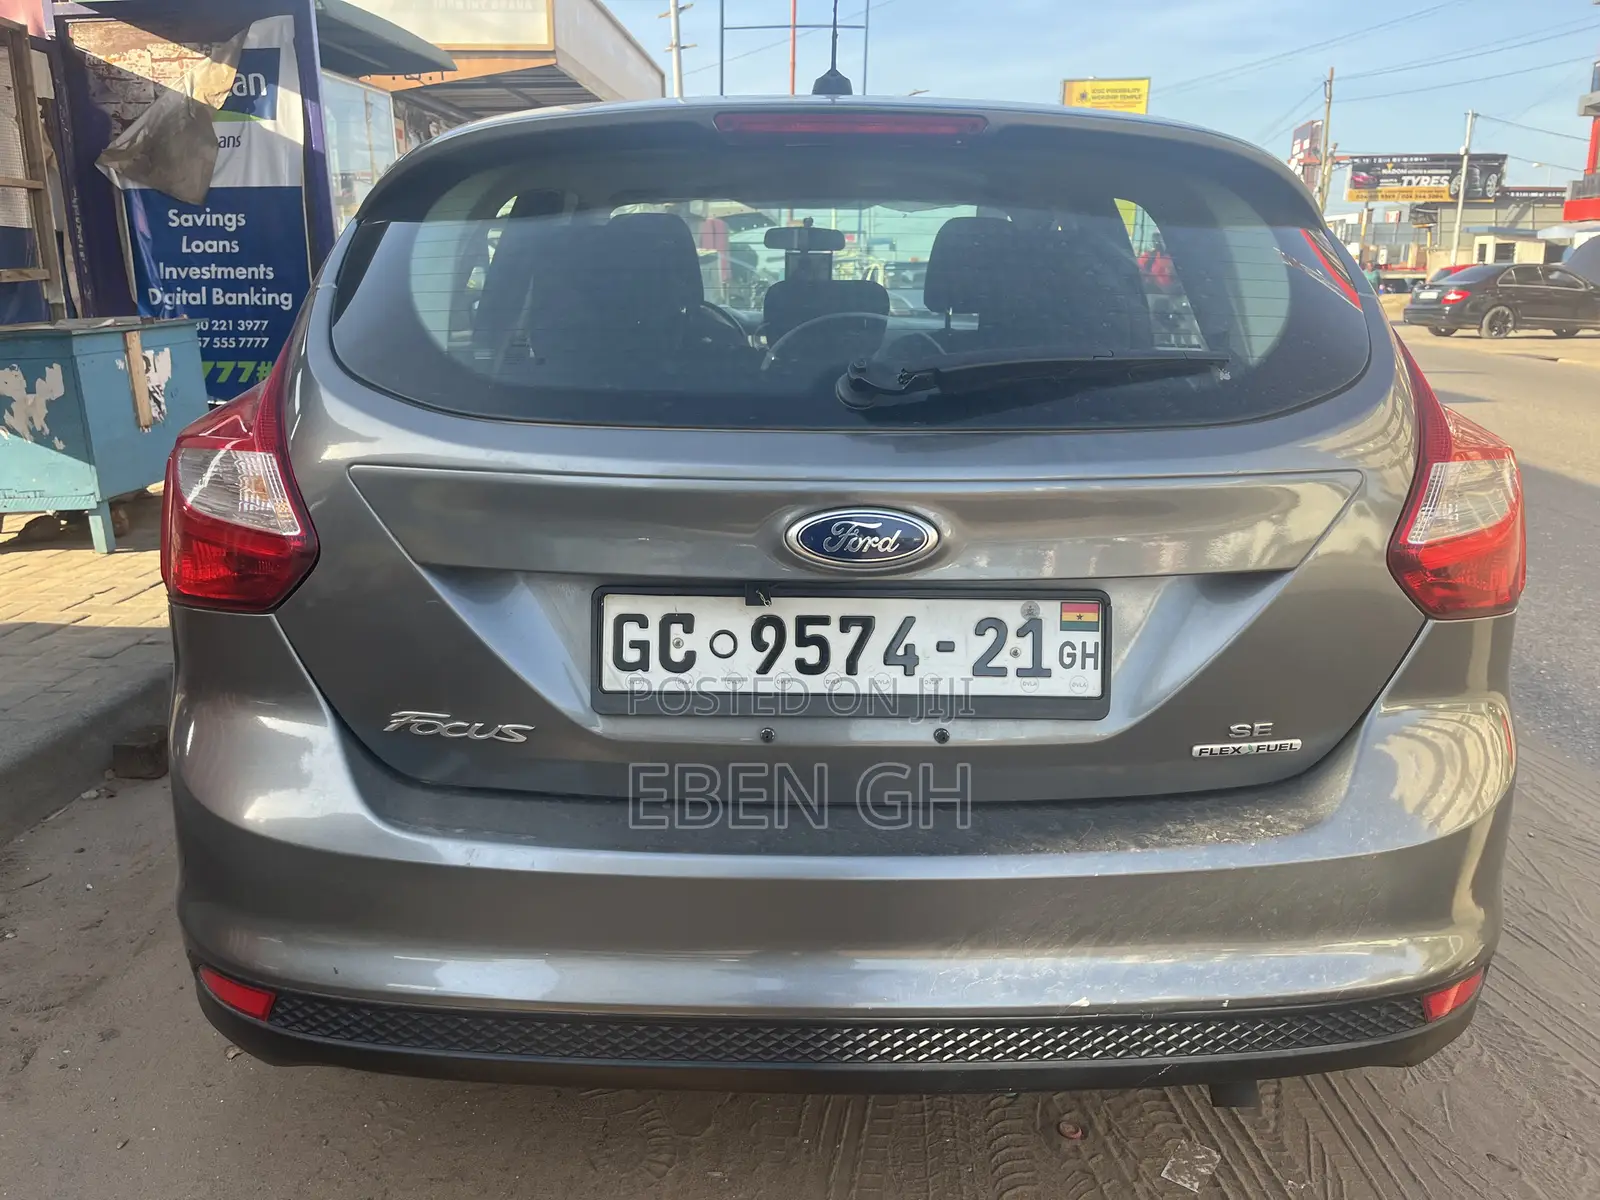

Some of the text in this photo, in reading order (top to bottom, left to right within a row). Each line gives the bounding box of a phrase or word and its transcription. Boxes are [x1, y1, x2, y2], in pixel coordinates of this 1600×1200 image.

[229, 73, 267, 97] an
[1401, 175, 1450, 187] TYRES
[168, 207, 246, 232] Savings
[181, 236, 240, 254] Loans
[159, 262, 275, 280] Investments
[212, 286, 293, 310] Banking
[211, 320, 233, 331] 221
[237, 320, 269, 331] 3977
[212, 337, 236, 348] 555
[238, 337, 269, 348] 7777
[823, 520, 902, 554] Ford
[613, 613, 697, 674] GC
[1058, 640, 1099, 671] GH
[1228, 722, 1274, 739] SE
[1198, 742, 1298, 757] FLEX FUEL
